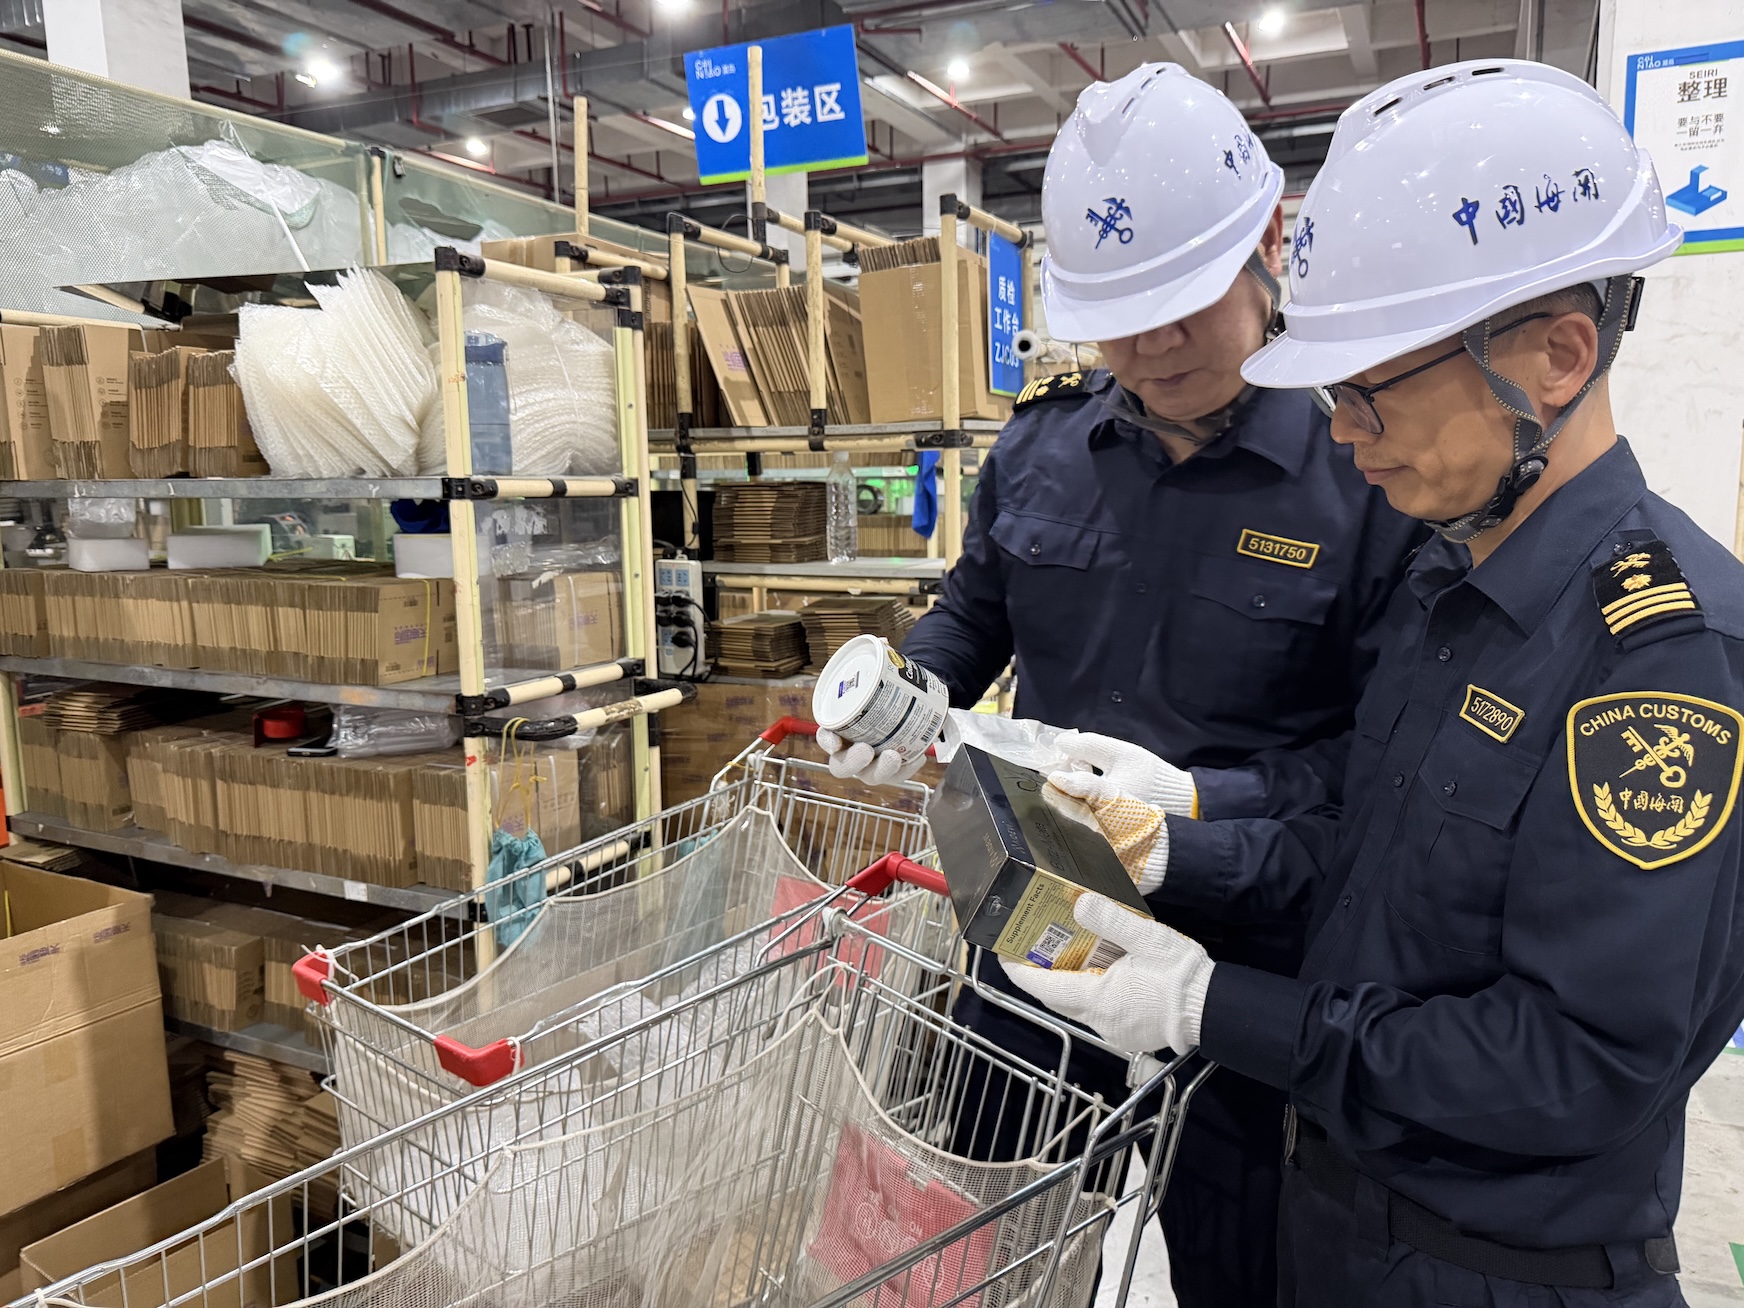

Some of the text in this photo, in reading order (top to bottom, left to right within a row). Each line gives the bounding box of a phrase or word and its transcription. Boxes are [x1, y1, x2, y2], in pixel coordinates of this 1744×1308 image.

[1689, 69, 1718, 79] SEIRI
[1677, 77, 1728, 103] 整理
[762, 82, 845, 131] 包装区
[1677, 112, 1724, 128] 要与不要
[994, 306, 1019, 336] 工作台
[1248, 537, 1307, 560] 5131750
[1470, 696, 1514, 731] 5172890
[1580, 703, 1732, 745] CHINA CUSTOMS
[1006, 903, 1034, 944] Supplement
[1029, 883, 1046, 903] Facts
